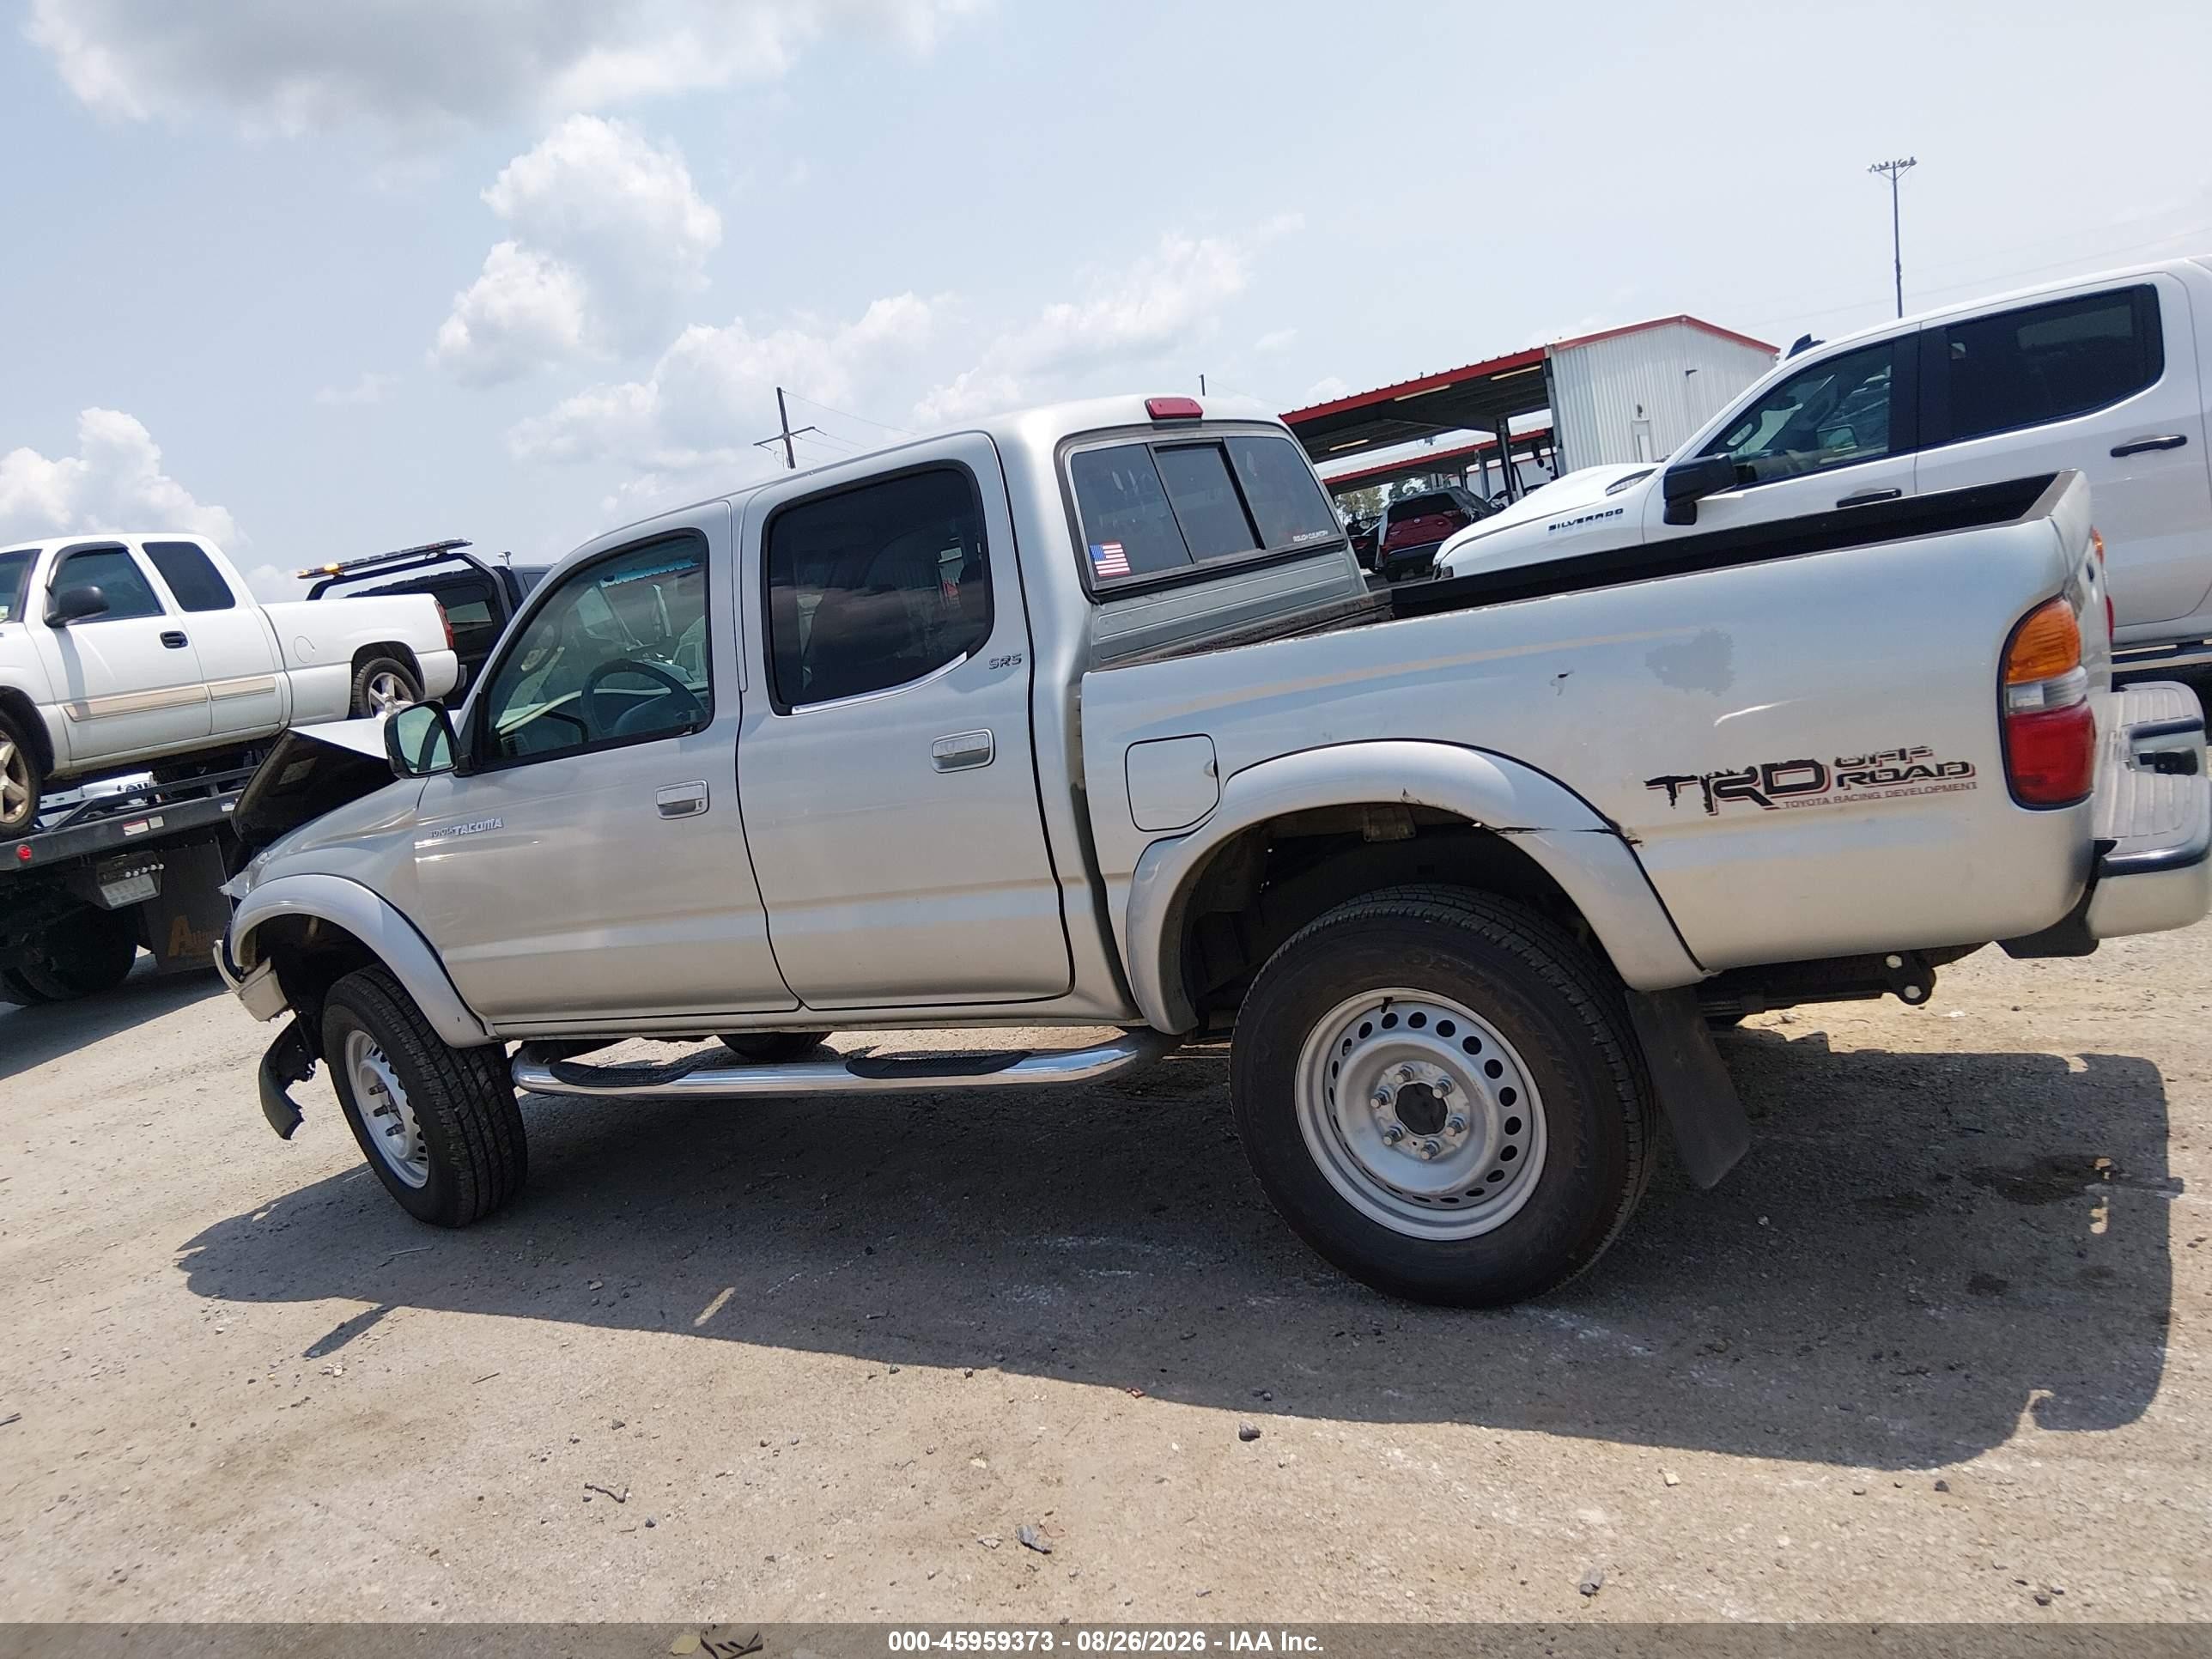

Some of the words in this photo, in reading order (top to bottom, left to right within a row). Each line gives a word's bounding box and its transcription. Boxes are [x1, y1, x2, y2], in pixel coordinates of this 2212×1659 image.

[1548, 508, 1624, 531] SILVERADO
[1644, 759, 1832, 816] TRD
[1836, 761, 1977, 790] ROAD
[1784, 798, 1830, 809] TOYOTA
[1833, 790, 1881, 804] RACING
[1885, 781, 1978, 798] DEVELOPMENT
[454, 818, 503, 836] TACOMA
